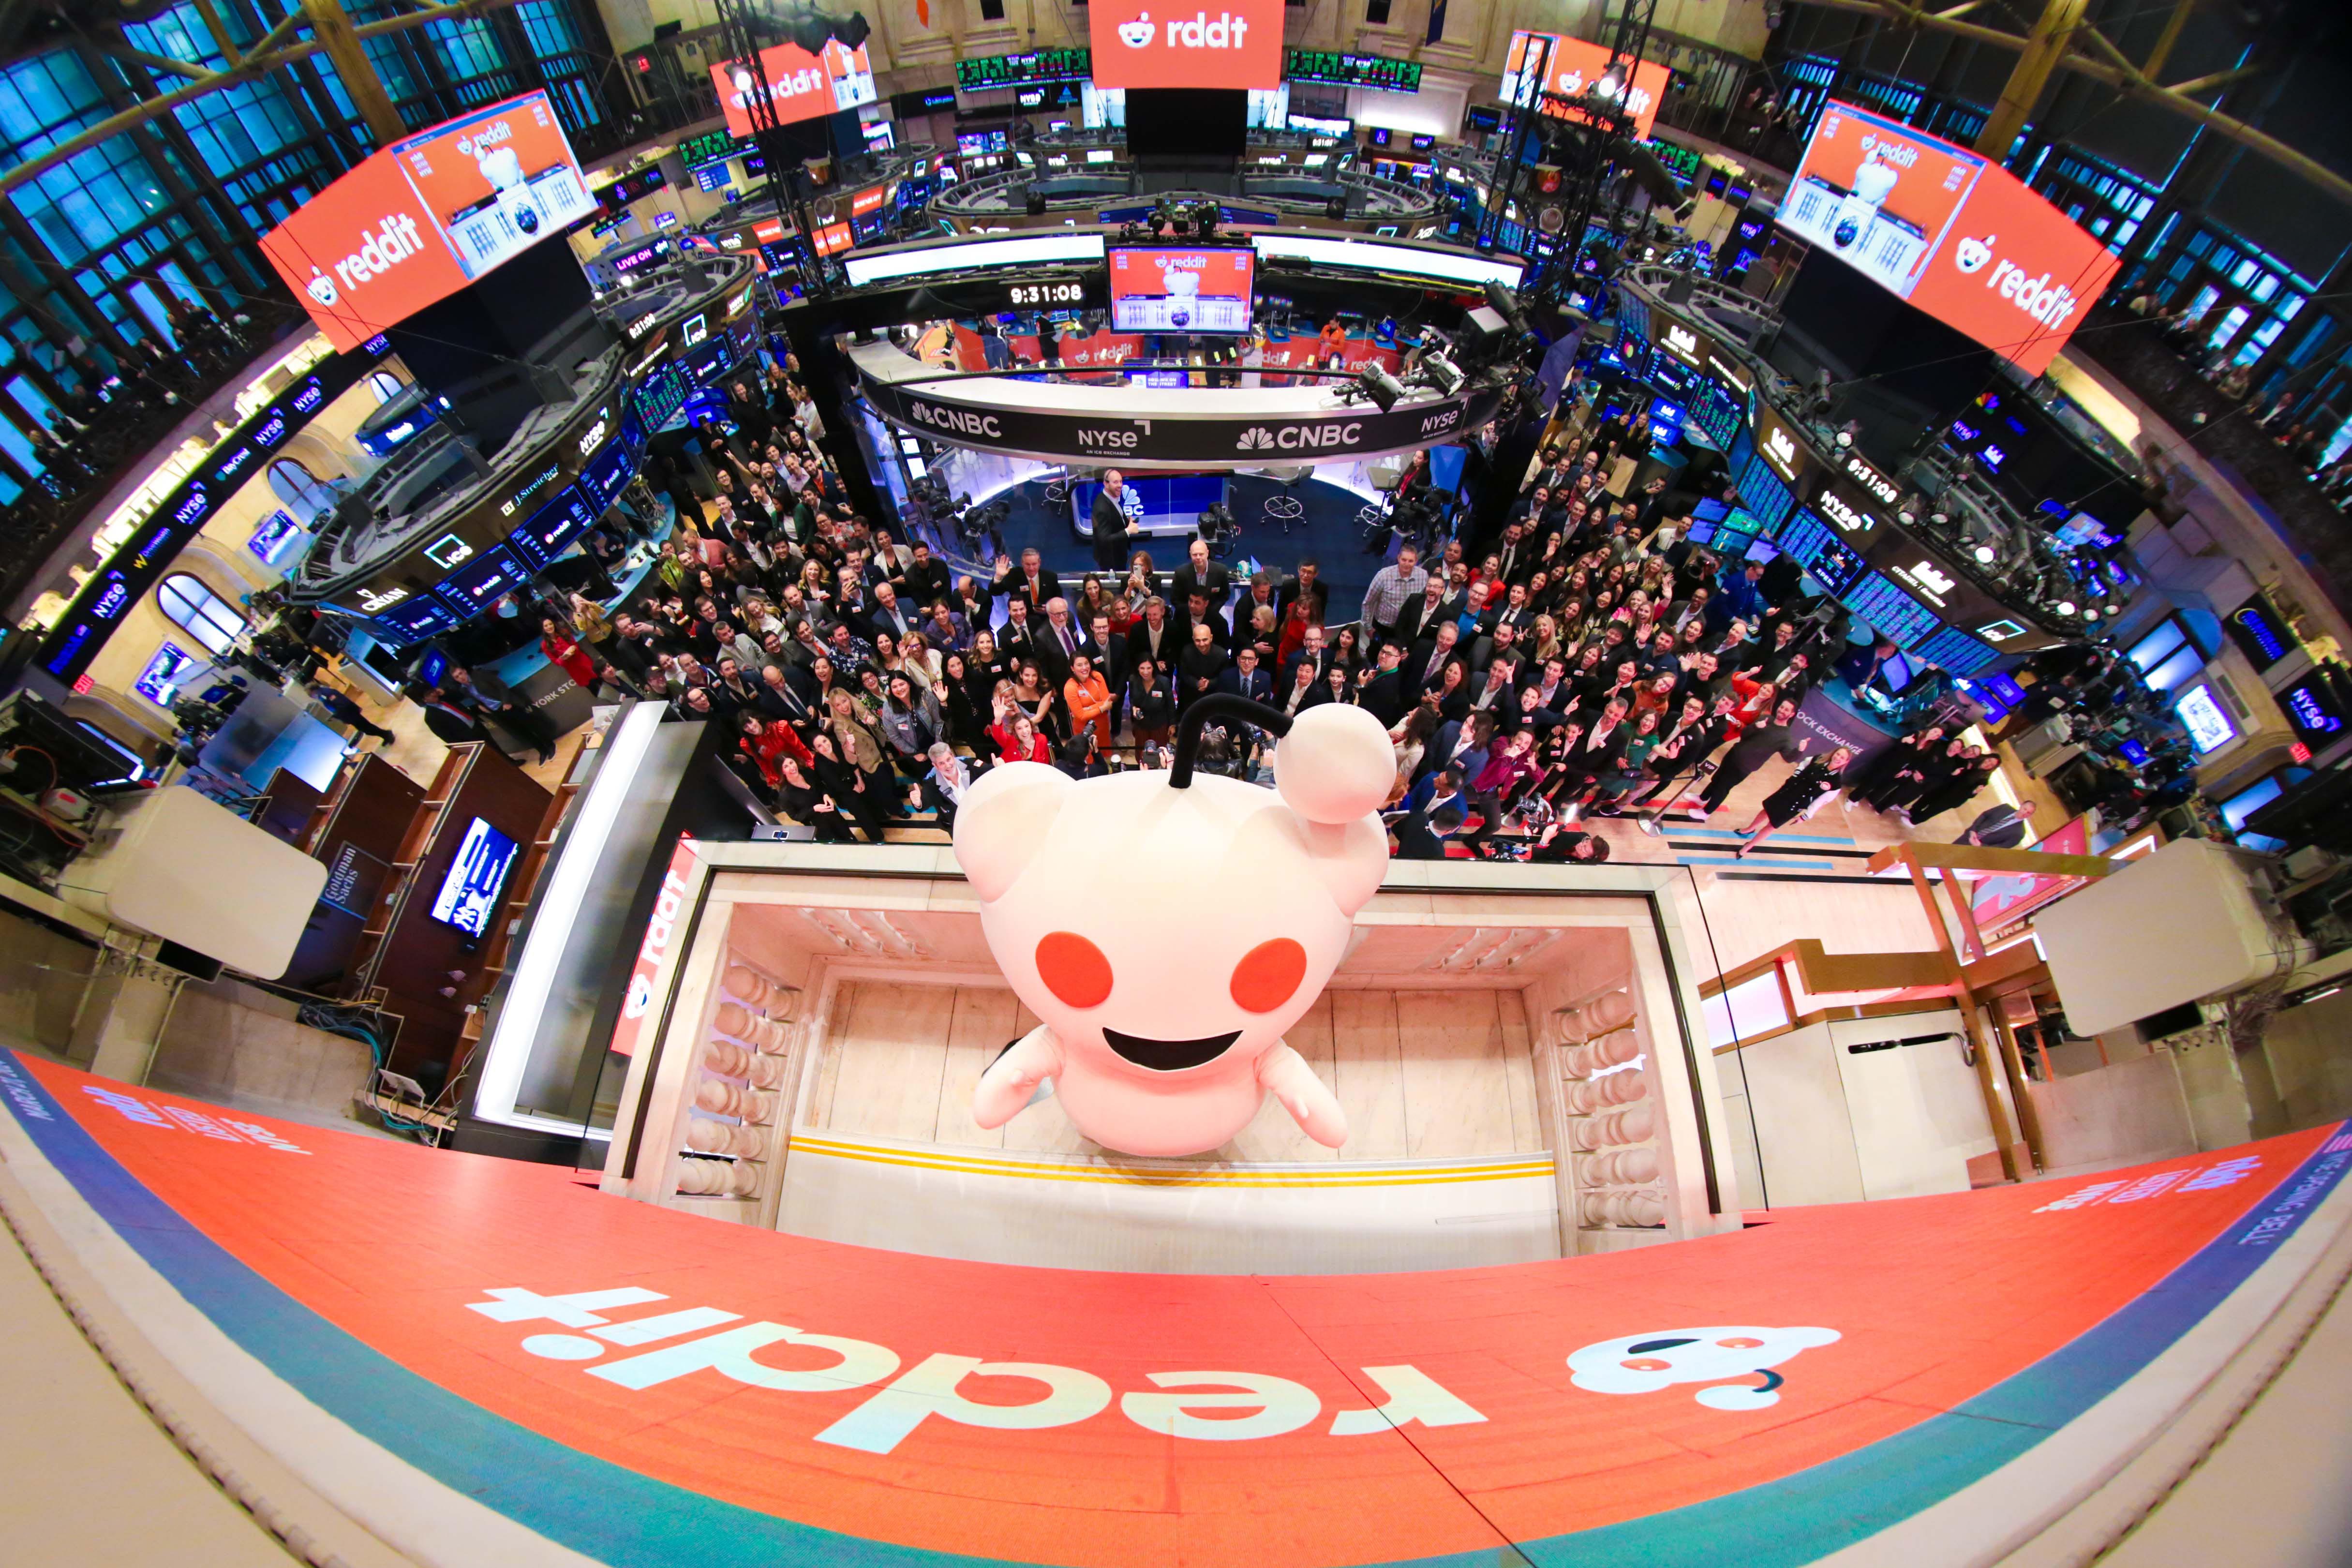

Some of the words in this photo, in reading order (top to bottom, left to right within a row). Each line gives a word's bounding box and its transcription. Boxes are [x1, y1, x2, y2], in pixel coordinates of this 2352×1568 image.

[1167, 12, 1248, 48] rddt
[473, 121, 512, 145] reddit
[1876, 141, 1920, 169] reddit
[334, 212, 425, 290] reddit
[616, 255, 638, 270] LIVE
[638, 249, 652, 261] ON
[1171, 255, 1207, 268] reddit
[1011, 284, 1082, 303] 9:31:08
[1987, 259, 2078, 329] reddit
[1658, 371, 1675, 386] Walmart
[293, 386, 321, 411] NYSE
[254, 418, 284, 445] NYSE
[934, 407, 1001, 438] CNBC
[1277, 423, 1362, 449] CNBC
[1078, 430, 1137, 448] NYSE
[515, 463, 559, 506] J.Streicher
[174, 492, 207, 524] NYSE
[551, 520, 571, 540] reddit
[481, 575, 502, 592] reddit
[91, 582, 126, 619] NYSE
[74, 674, 94, 695] EXIT
[532, 691, 559, 709] YORK
[557, 679, 577, 694] STO
[2292, 688, 2325, 729] NYSE
[1797, 710, 1817, 729] OCK
[1816, 725, 1864, 755] EXCHANGE
[1703, 762, 1715, 770] VIP
[325, 848, 357, 899] Goldman
[335, 869, 358, 904] Sachs
[641, 869, 686, 966] rddt
[463, 1285, 1490, 1455] reddit
